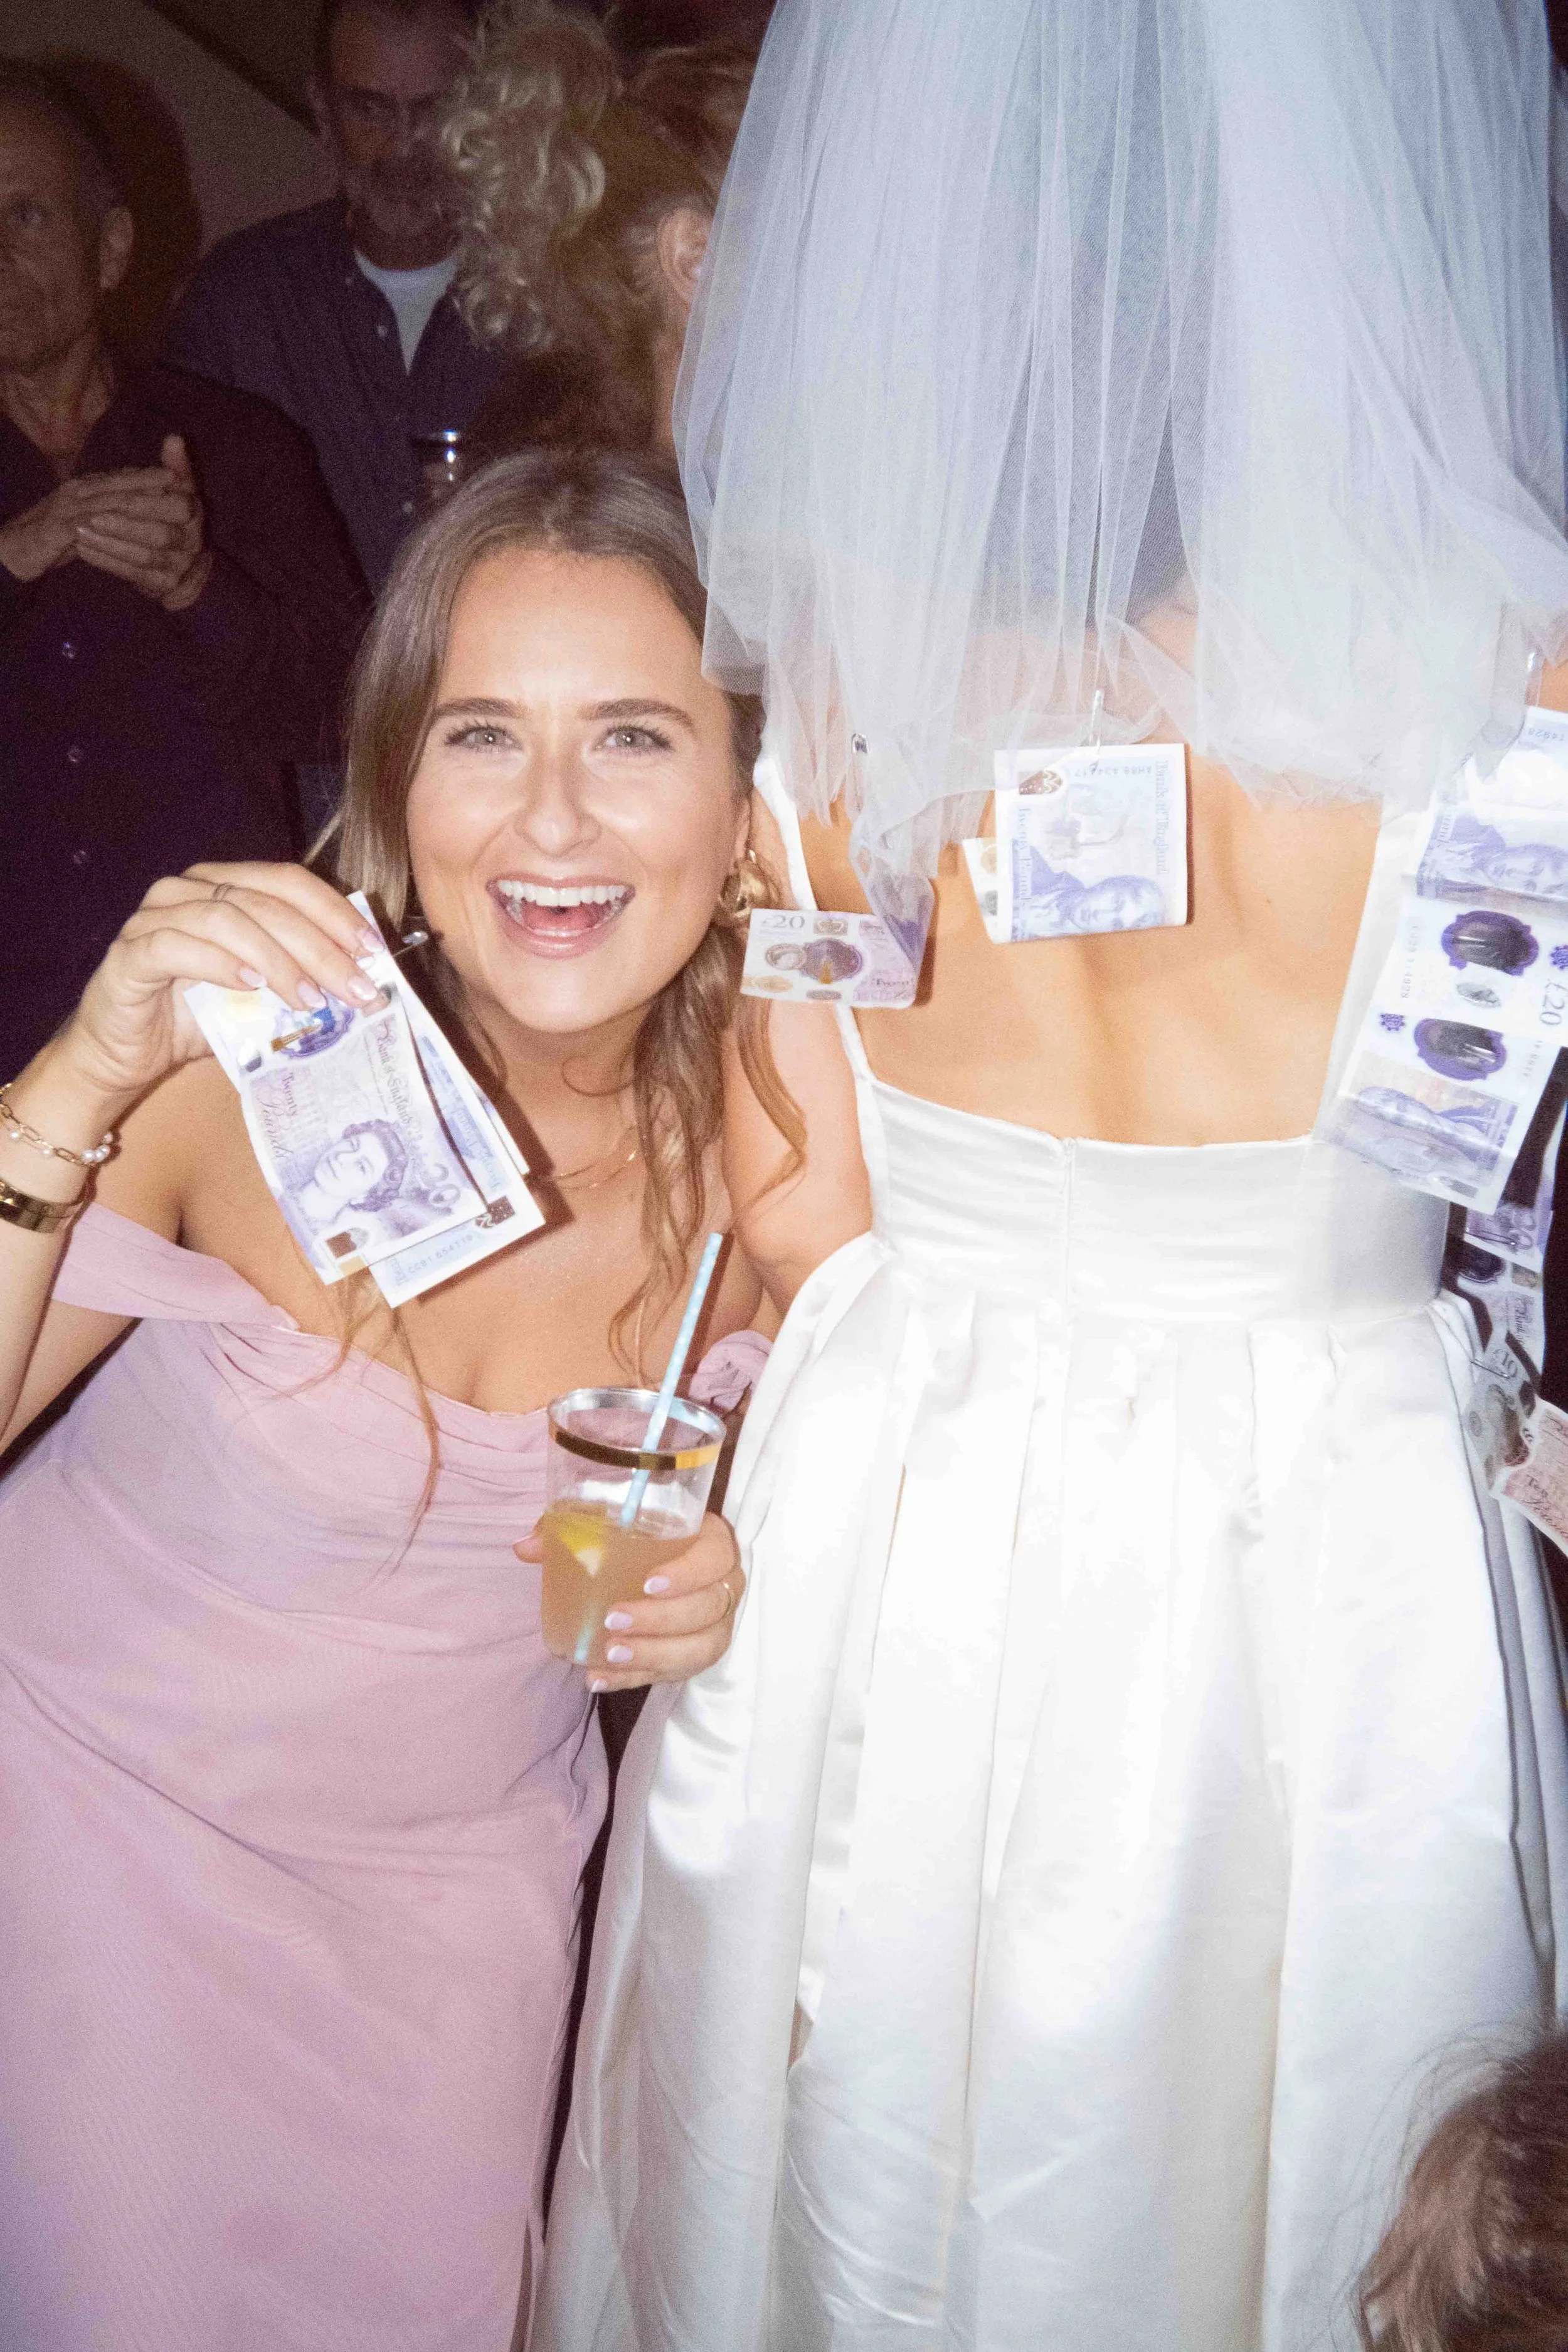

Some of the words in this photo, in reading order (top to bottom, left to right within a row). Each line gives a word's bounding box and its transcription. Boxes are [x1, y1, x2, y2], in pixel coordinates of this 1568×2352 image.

[1018, 808, 1031, 852] Twenty
[1153, 818, 1170, 875] England
[761, 914, 805, 929] £20
[1539, 982, 1568, 1026] £20
[282, 1072, 299, 1117] Twenty
[376, 1021, 396, 1065] Bank
[386, 1074, 409, 1125] England
[255, 1094, 294, 1158] Pounds
[421, 1162, 461, 1211] 20
